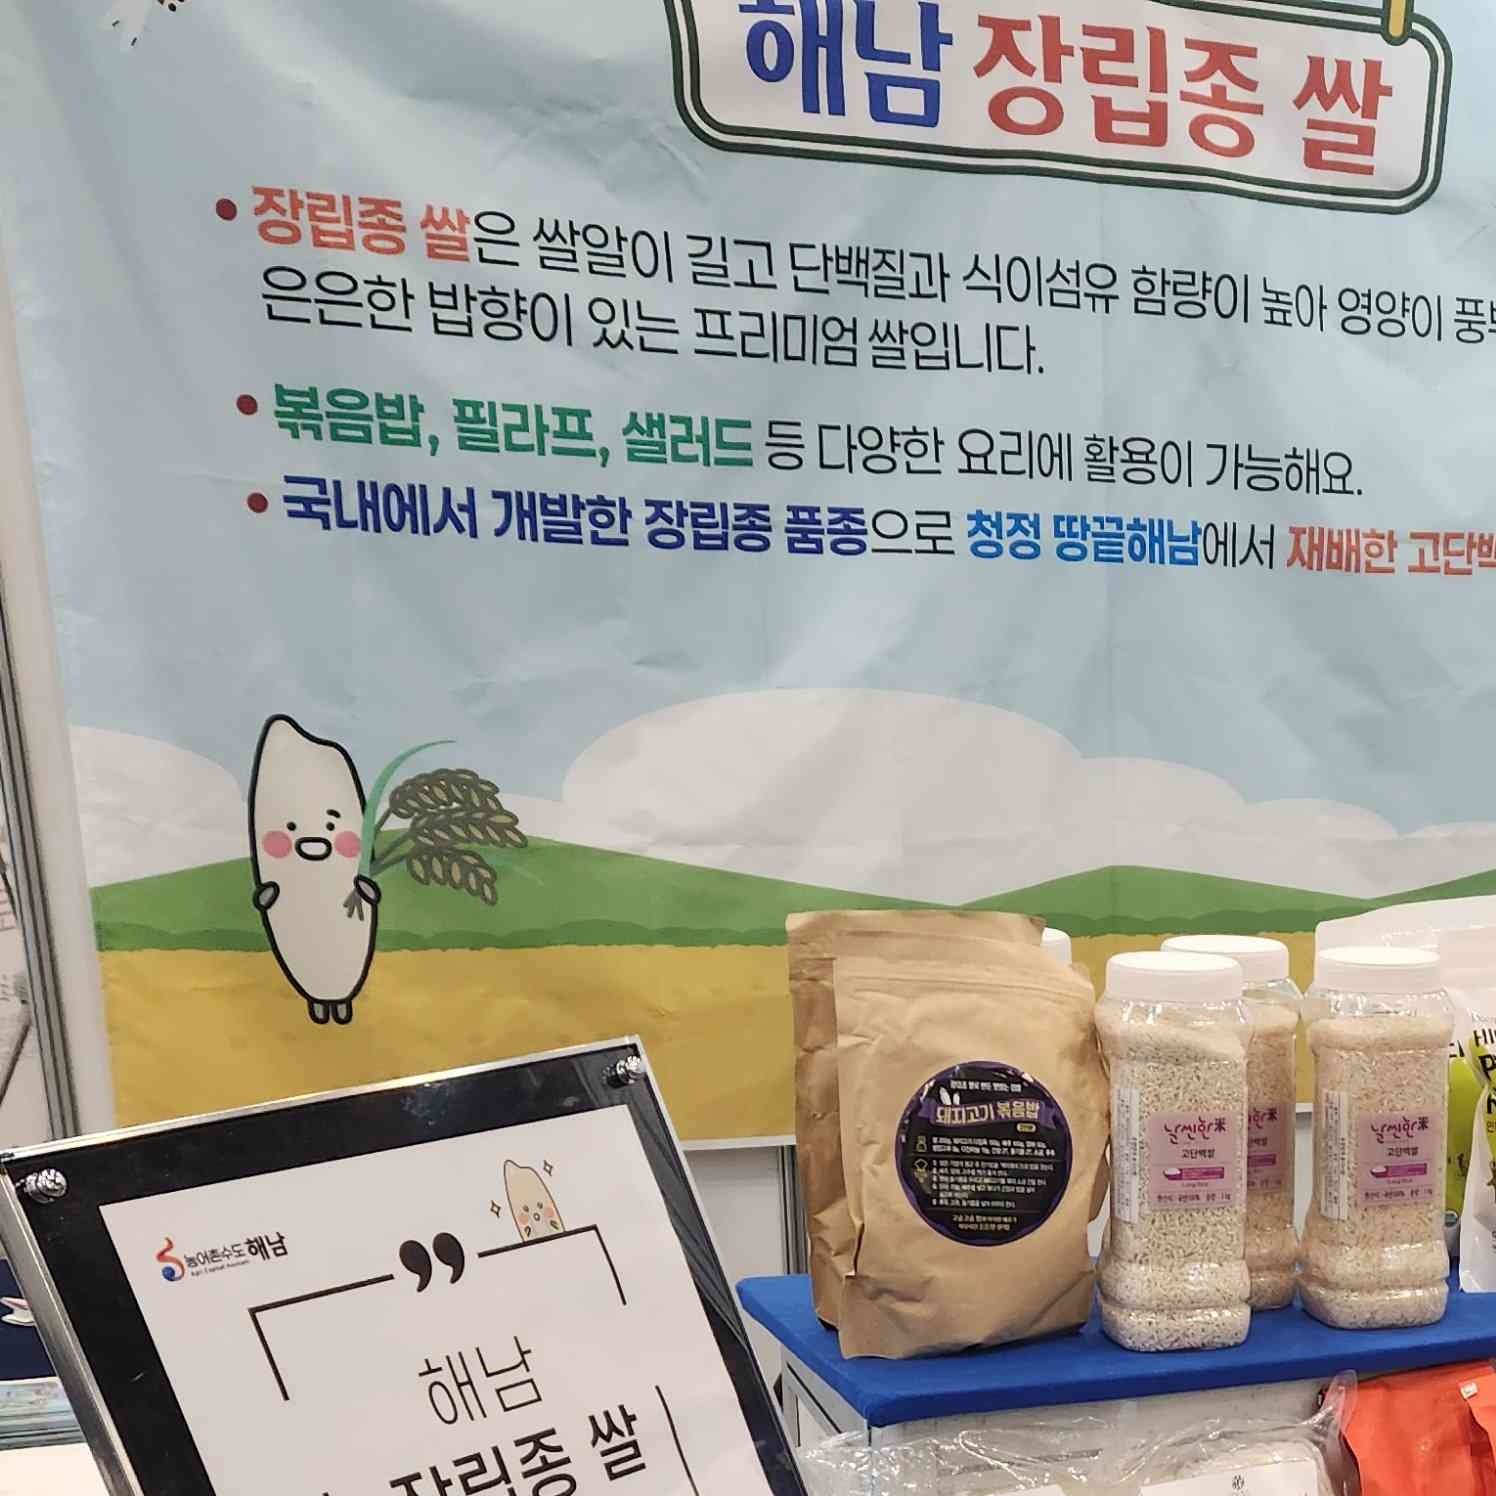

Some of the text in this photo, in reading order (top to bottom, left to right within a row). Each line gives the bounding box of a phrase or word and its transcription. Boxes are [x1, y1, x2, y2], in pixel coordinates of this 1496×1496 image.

[738, 0, 1394, 177] 해남 장립종 쌀
[250, 185, 408, 257] 장립종
[419, 203, 520, 270] 쌀은
[533, 217, 676, 284] 쌀알이
[686, 233, 775, 292] 길고
[789, 241, 951, 304] 단백질과
[961, 253, 1121, 316] 식이섬유
[1130, 264, 1251, 323] 함량이
[1260, 277, 1328, 333] 높아
[1338, 285, 1444, 344] 영양이
[260, 264, 1045, 378] 은은한 밥향이 있는 프리미엄 쌀입니다.
[273, 383, 1365, 498] 볶음밥, 필라프, 샐러드 등 다양한 요리에 활용이 가능해요.
[283, 474, 480, 541] 국내에서
[492, 487, 631, 549] 개발한
[643, 496, 774, 554] 장립종
[784, 504, 957, 558] 품종으로
[966, 508, 1042, 562] 청정
[1052, 512, 1276, 571] 땅끝해남에서
[1286, 524, 1399, 577] 재배한
[244, 1231, 289, 1262] 해남
[418, 1335, 543, 1425] 해남
[588, 1404, 646, 1482] 쌀
